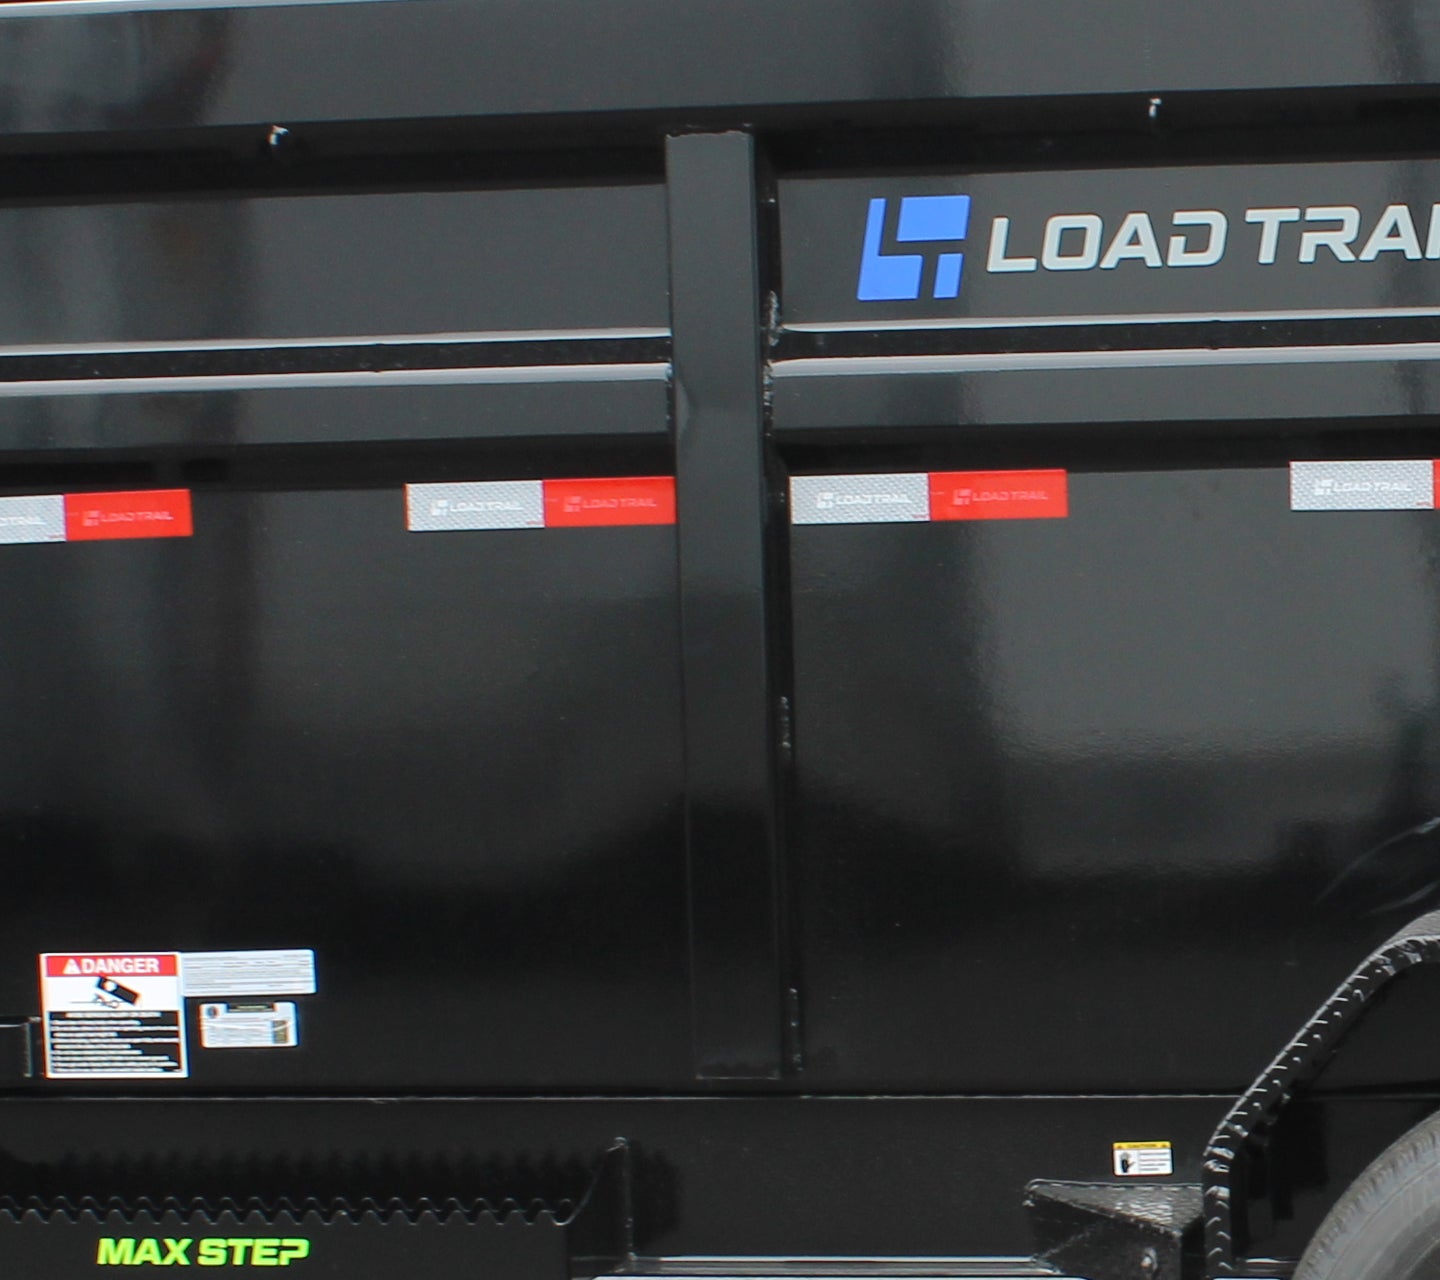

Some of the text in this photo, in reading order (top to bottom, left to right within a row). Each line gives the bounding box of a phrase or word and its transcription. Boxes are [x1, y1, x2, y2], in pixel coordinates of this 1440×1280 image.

[985, 209, 1228, 273] LOAD
[80, 957, 160, 974] DANGER
[95, 1237, 310, 1267] MAX STEP
